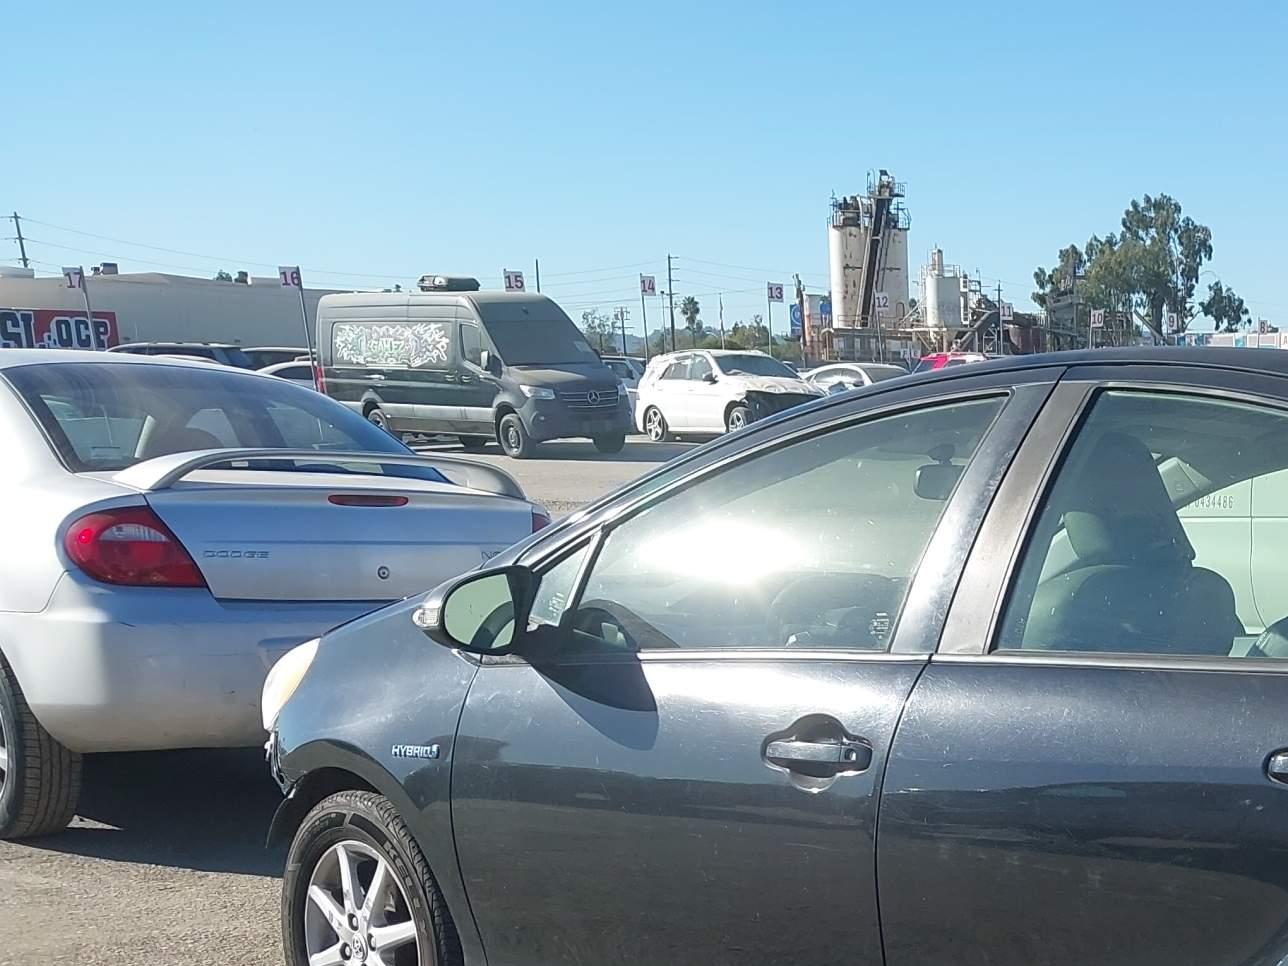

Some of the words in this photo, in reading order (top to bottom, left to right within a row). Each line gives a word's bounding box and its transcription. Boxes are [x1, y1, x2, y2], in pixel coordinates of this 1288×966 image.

[64, 272, 81, 288] 17
[280, 271, 300, 286] 16
[505, 274, 524, 289] 15
[641, 279, 655, 293] 14
[768, 286, 783, 299] 13
[877, 296, 888, 308] 12
[1001, 306, 1012, 317] 11
[1092, 313, 1103, 323] 10
[1168, 315, 1175, 327] 9
[203, 550, 271, 559] DODGE
[391, 744, 432, 758] HYBRID
